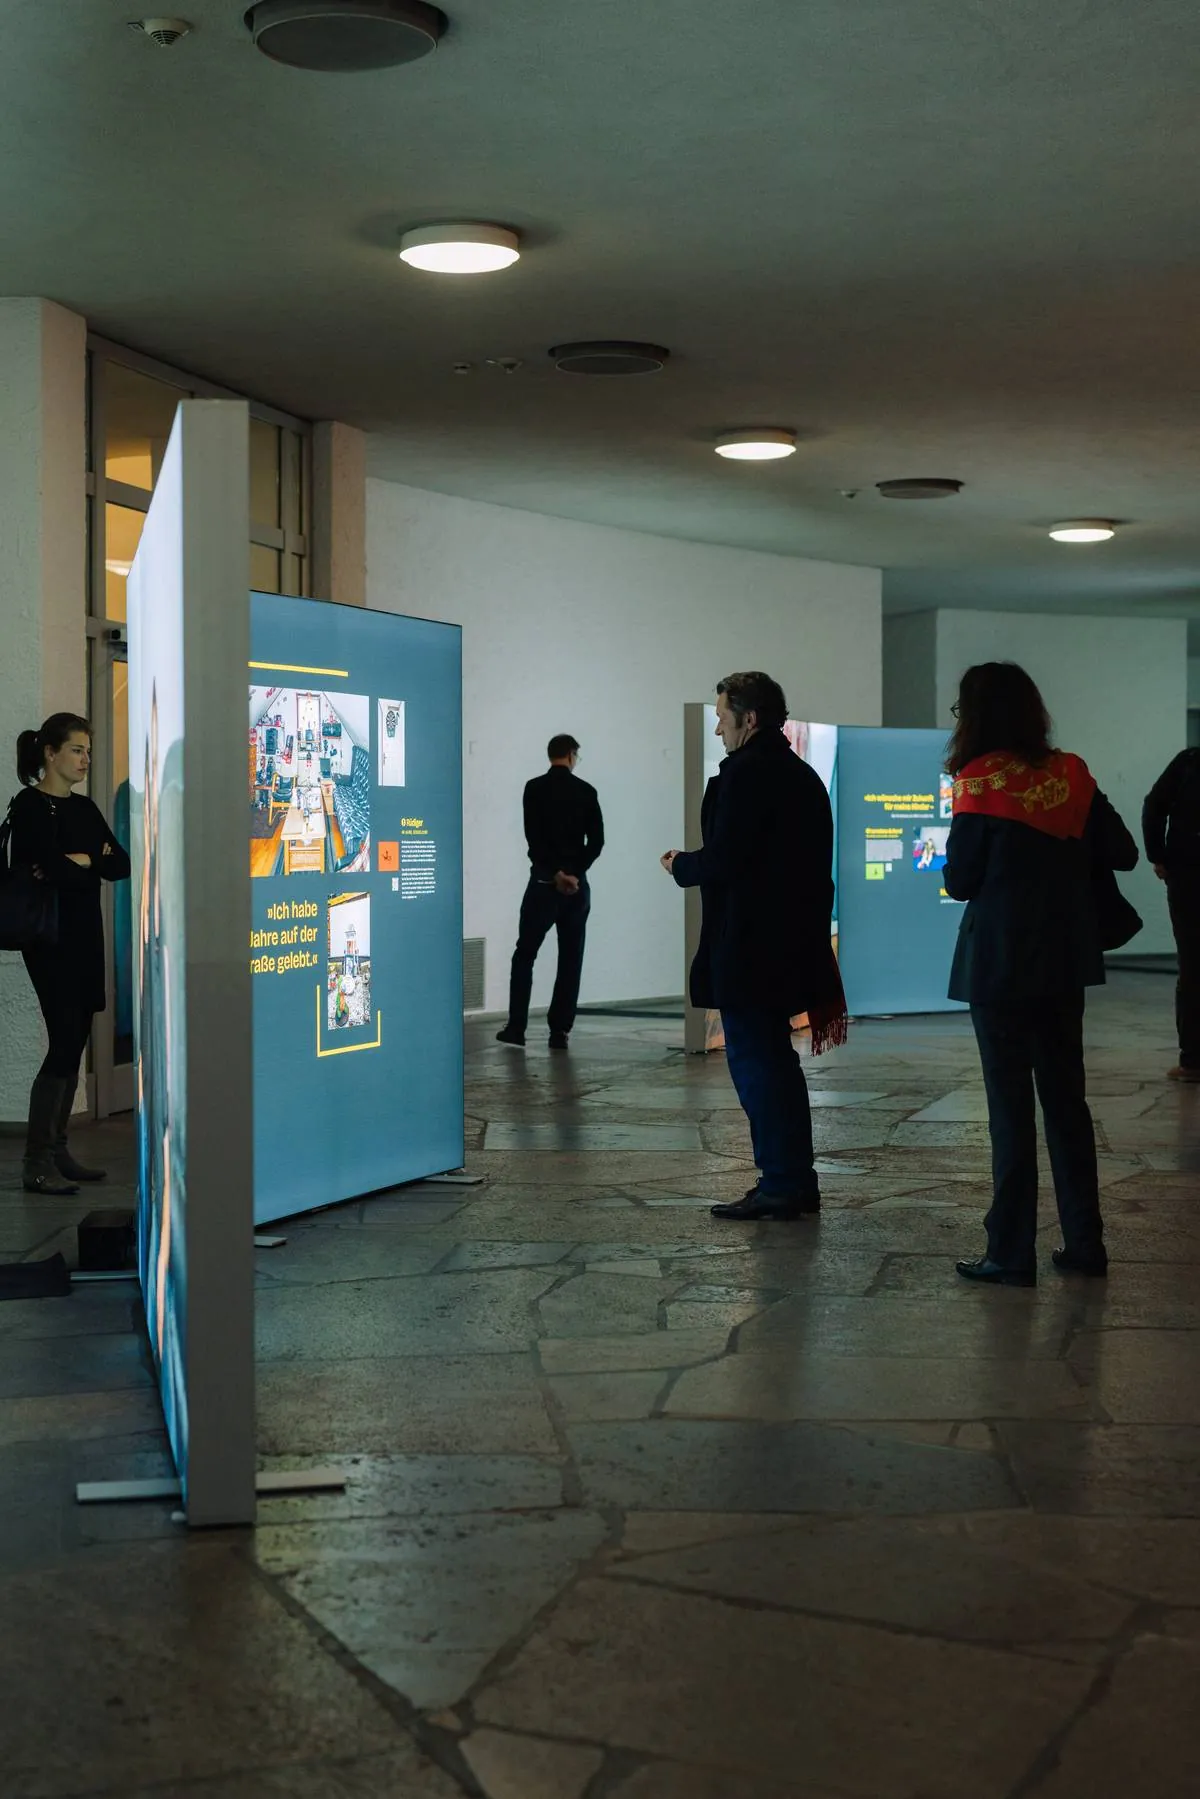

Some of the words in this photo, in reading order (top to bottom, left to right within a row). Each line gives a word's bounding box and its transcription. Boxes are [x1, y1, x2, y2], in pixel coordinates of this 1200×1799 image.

[267, 901, 290, 920] »Ich
[291, 899, 318, 919] habe
[280, 925, 298, 945] auf
[300, 924, 318, 943] der
[277, 950, 318, 975] gelebt.«
